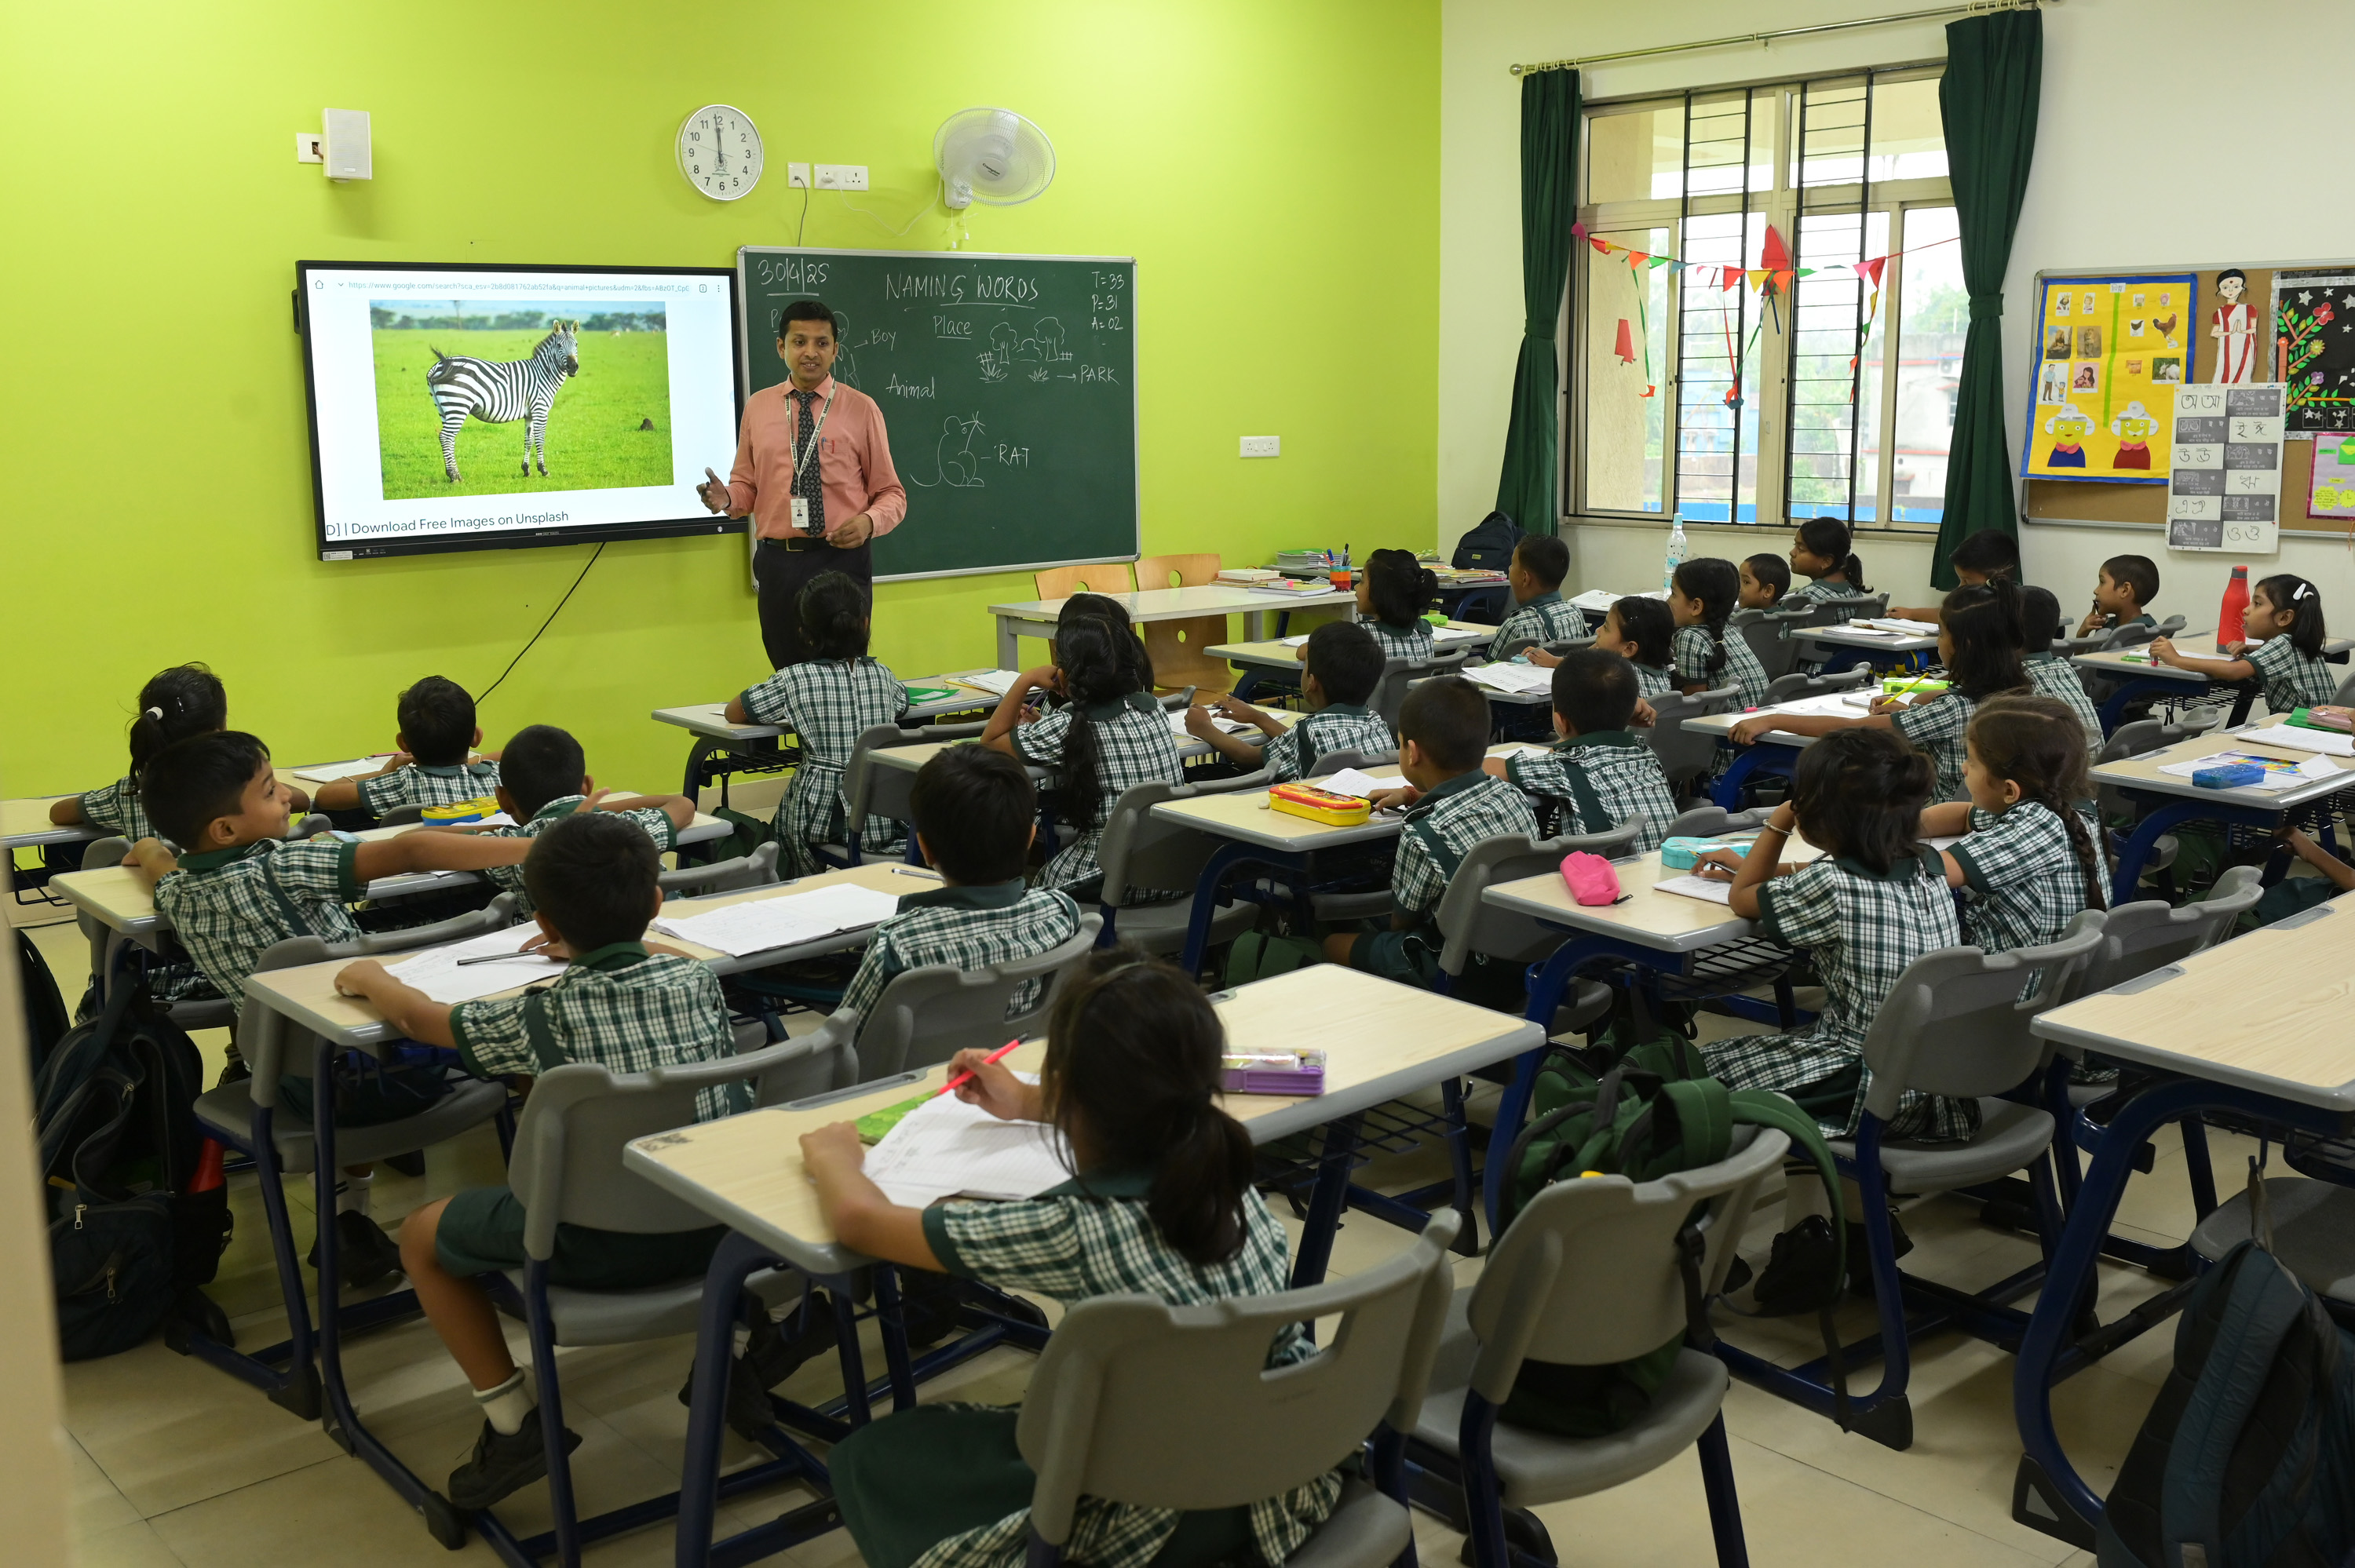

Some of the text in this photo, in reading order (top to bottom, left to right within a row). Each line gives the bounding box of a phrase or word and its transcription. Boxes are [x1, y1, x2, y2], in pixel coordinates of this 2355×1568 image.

[700, 119, 709, 129] 11
[730, 120, 735, 130] 1
[690, 132, 700, 141] 10
[740, 133, 747, 142] 2
[688, 148, 695, 157] 9
[745, 149, 751, 159] 3
[693, 164, 699, 174] 8
[742, 165, 748, 175] 4
[704, 177, 710, 186] 7
[719, 181, 725, 191] 6
[733, 177, 739, 187] 5
[886, 273, 1039, 304] NAMING WORDS
[933, 315, 973, 334] Place
[871, 329, 896, 352] Boy
[1080, 364, 1120, 385] PARK
[885, 373, 935, 399] Animal
[2181, 395, 2220, 409] অ আ
[805, 444, 813, 459] WORLD
[810, 430, 819, 445] PUBLIC
[816, 415, 825, 431] SCHOOL
[999, 443, 1029, 469] RAT
[2178, 448, 2190, 462] উ
[2175, 499, 2188, 513] এ
[352, 520, 416, 534] Download
[420, 519, 447, 530] Free
[451, 516, 495, 530] Images
[498, 516, 513, 524] on
[516, 511, 568, 526] Unsplash
[2227, 527, 2240, 541] ও
